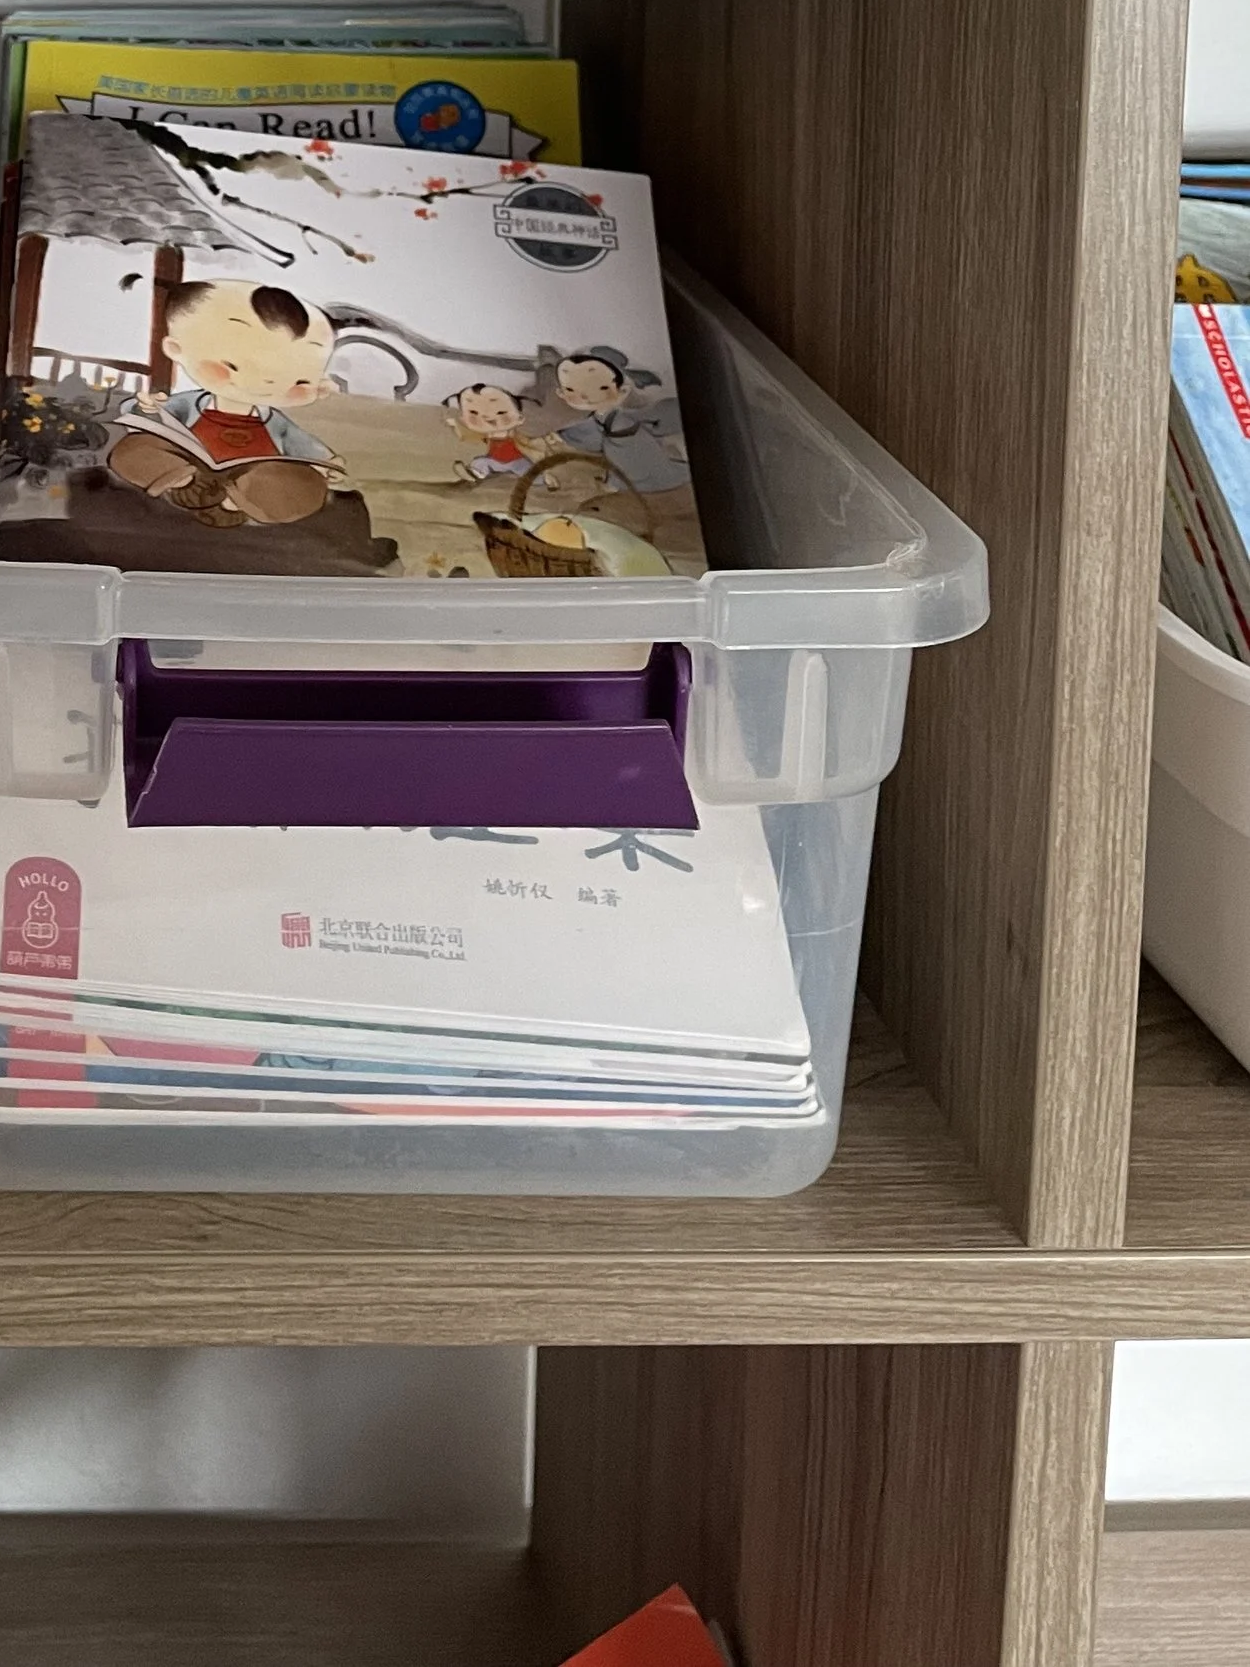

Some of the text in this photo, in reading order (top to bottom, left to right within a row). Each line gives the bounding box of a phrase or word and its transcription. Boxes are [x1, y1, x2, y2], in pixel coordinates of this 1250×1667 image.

[257, 109, 377, 139] Read!
[17, 872, 70, 893] HOLLO
[577, 886, 622, 909] 编著
[318, 917, 465, 949] 北京联合出版公司
